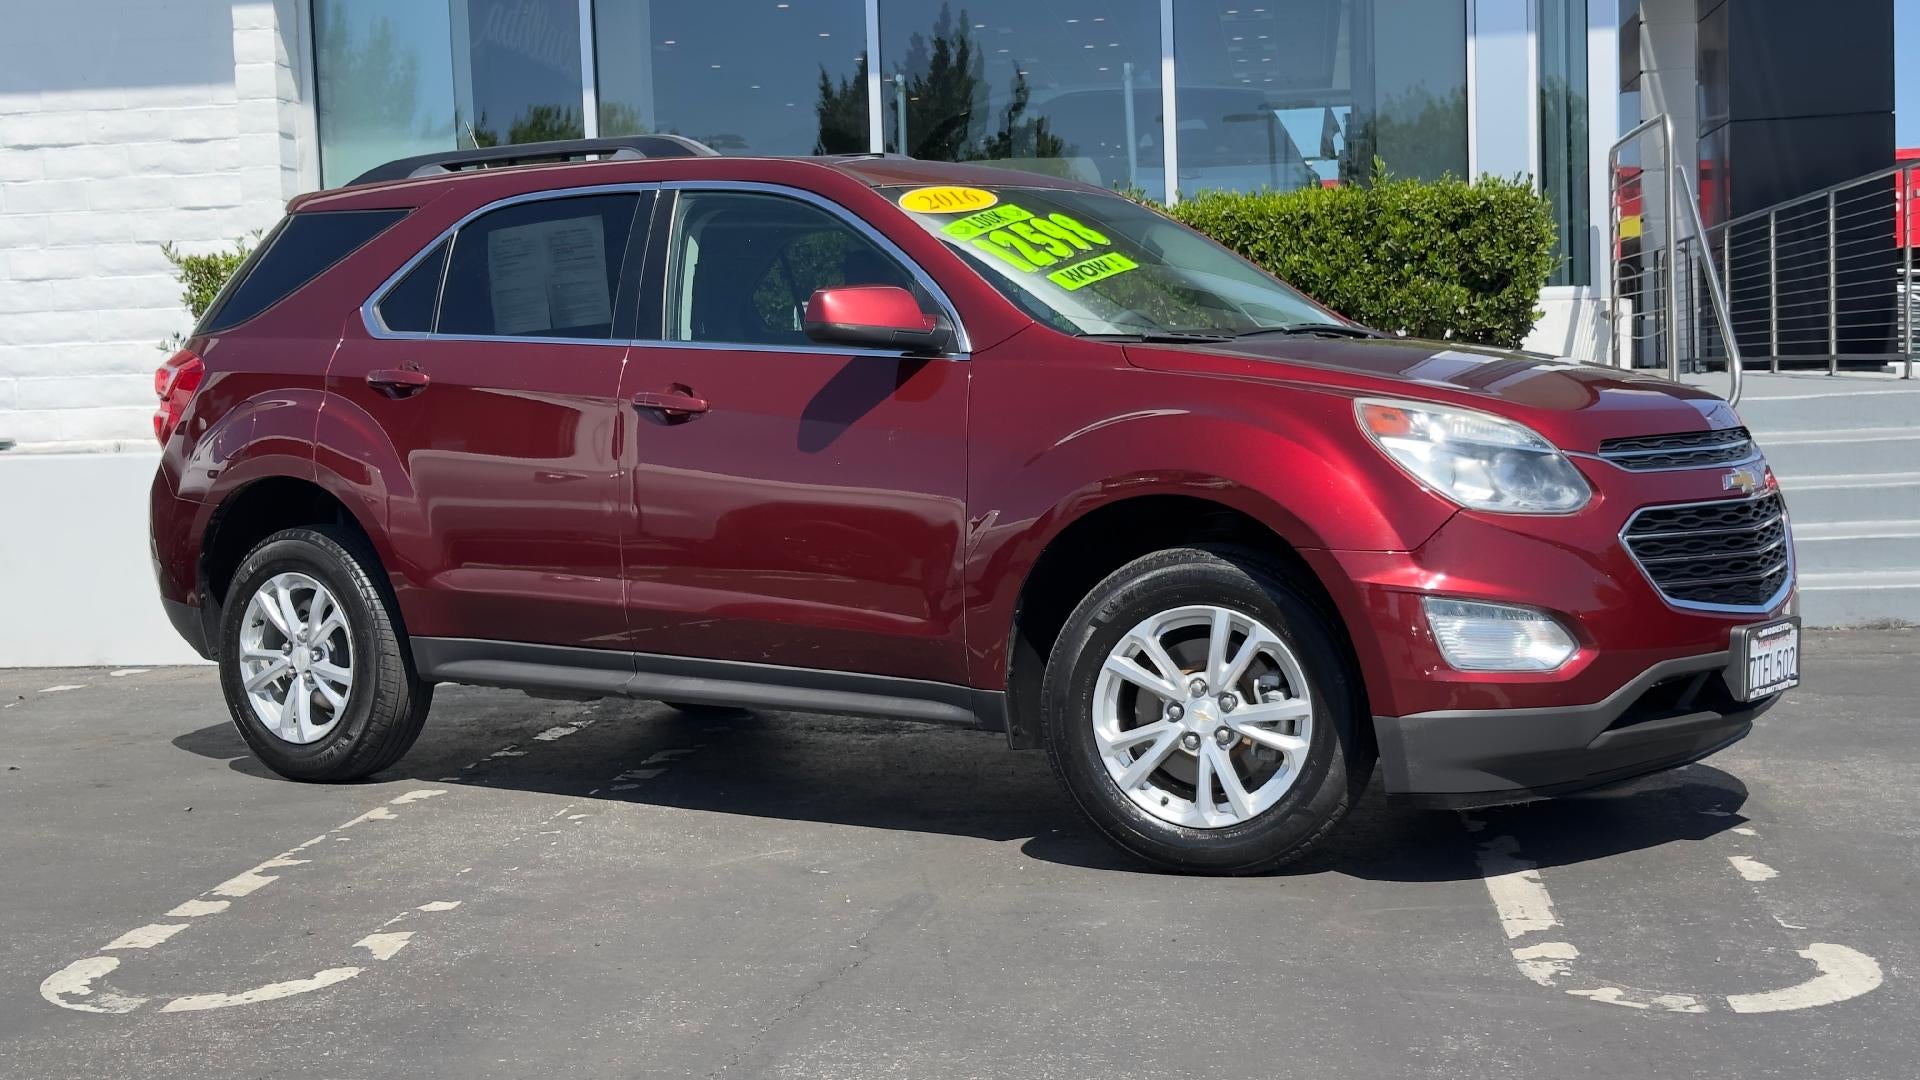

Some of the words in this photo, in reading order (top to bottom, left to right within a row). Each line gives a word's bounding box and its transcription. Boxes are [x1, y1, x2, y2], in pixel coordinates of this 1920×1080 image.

[918, 190, 981, 210] 2016
[964, 210, 1009, 229] LOOK
[971, 213, 1111, 273] 12598
[1749, 646, 1797, 690] 7TFL502
